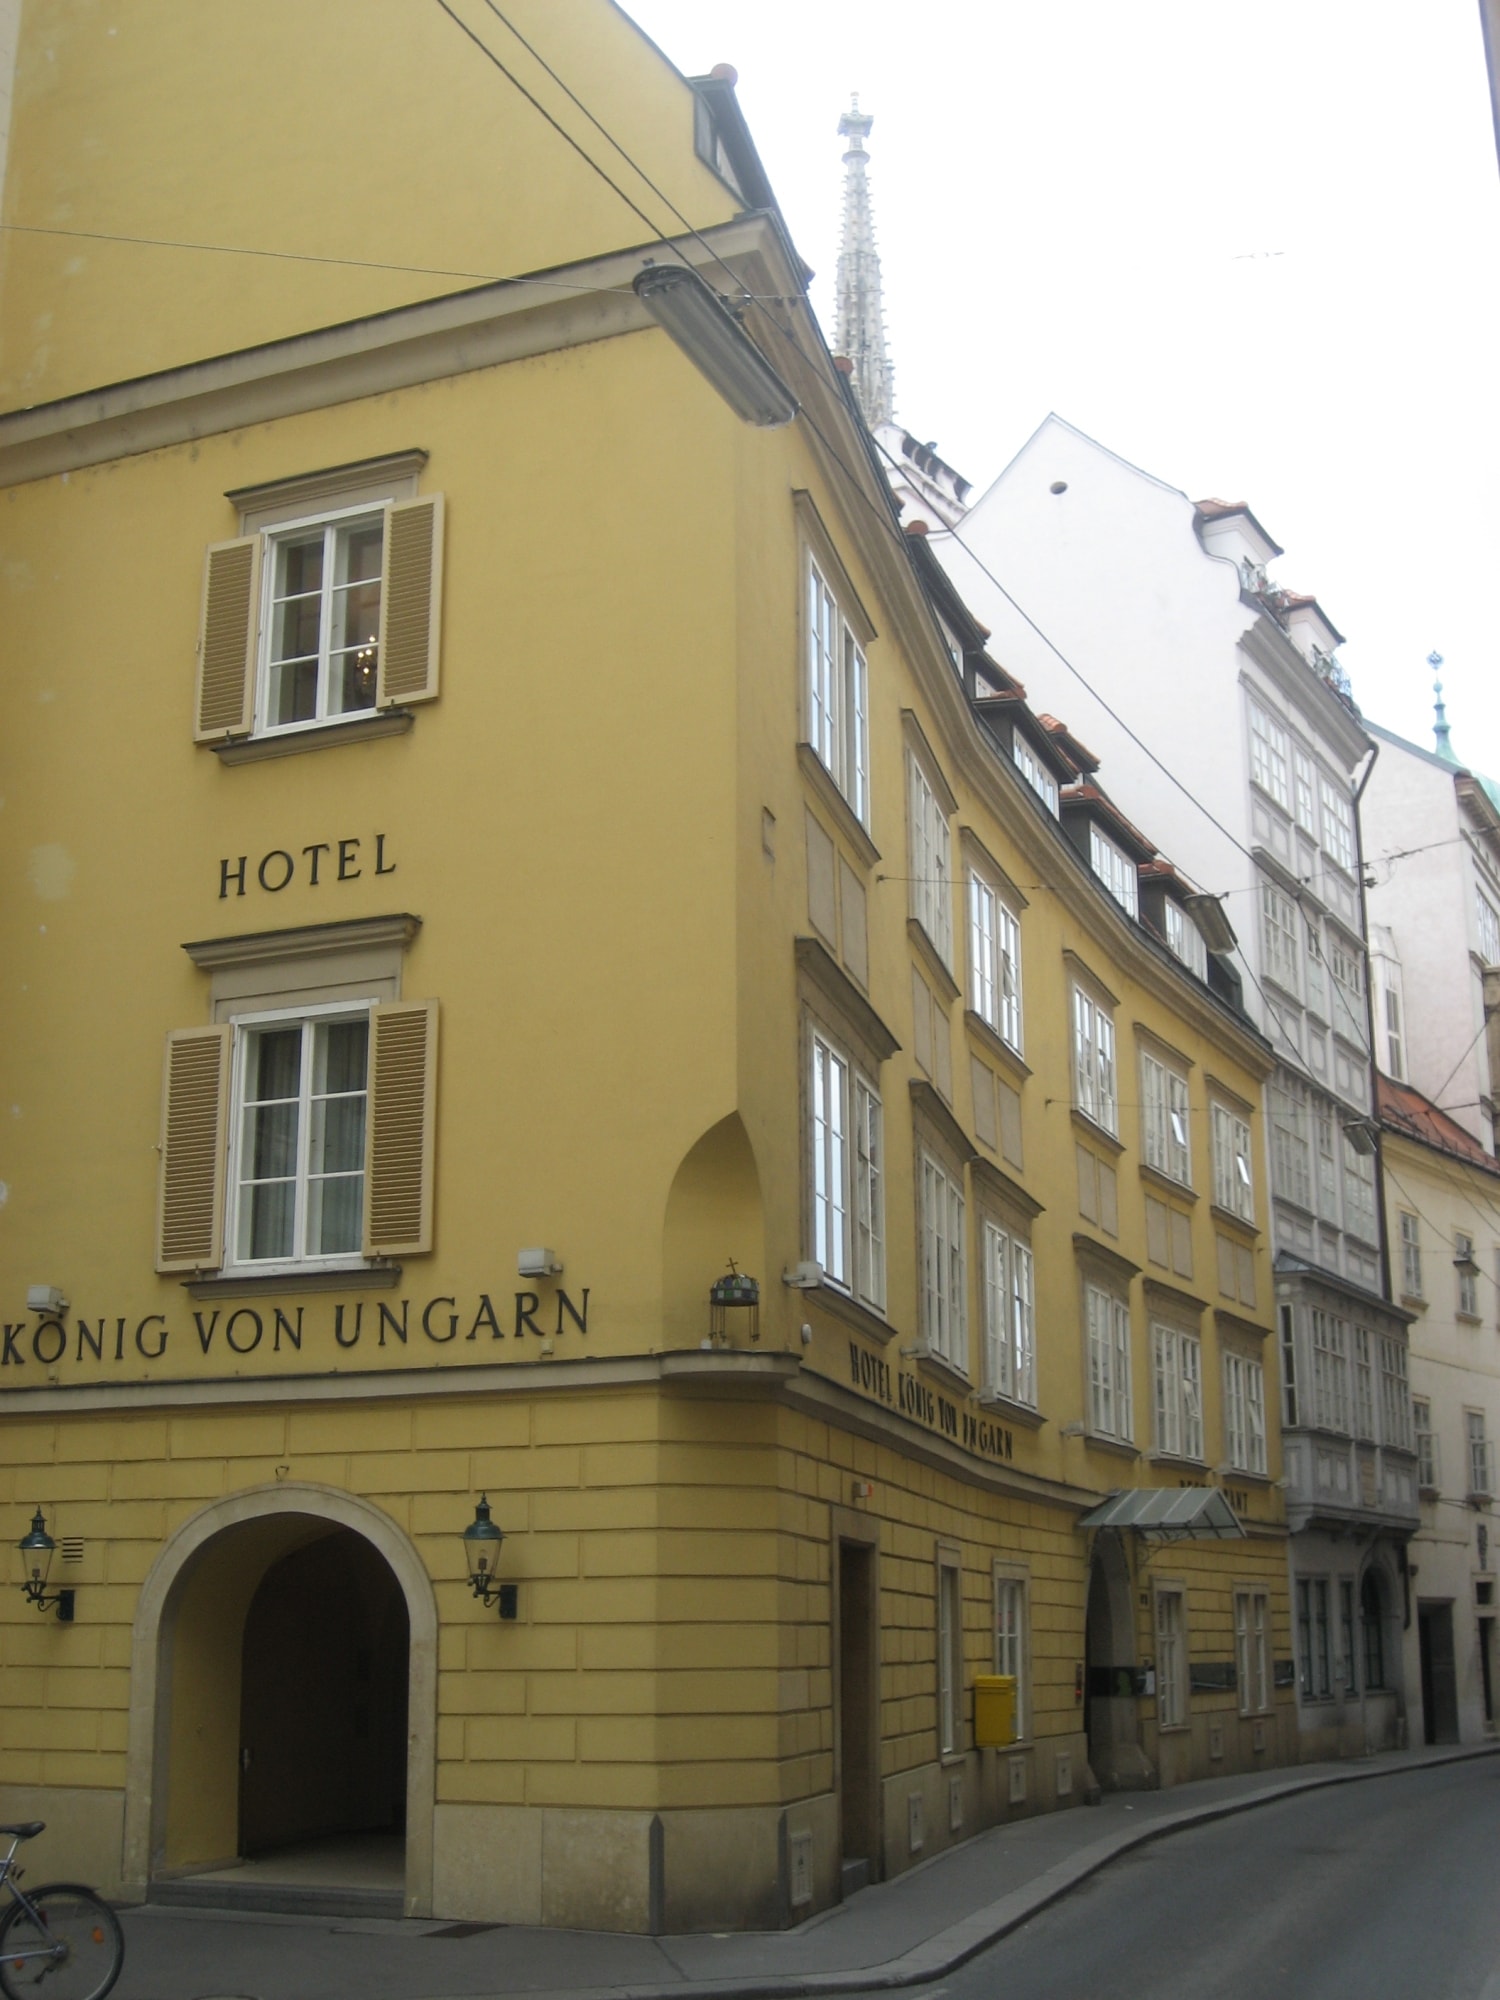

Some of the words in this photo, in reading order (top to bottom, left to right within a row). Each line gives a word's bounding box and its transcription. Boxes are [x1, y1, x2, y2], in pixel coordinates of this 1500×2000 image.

[218, 833, 397, 899] HOTEL
[1, 1312, 169, 1366] KÖNIG
[193, 1306, 304, 1355] VON
[334, 1287, 591, 1348] UNGARN
[849, 1340, 892, 1402] HOTEL
[898, 1371, 934, 1425] KÖNIG
[938, 1396, 957, 1438] VON
[963, 1413, 1012, 1460] UNGARN
